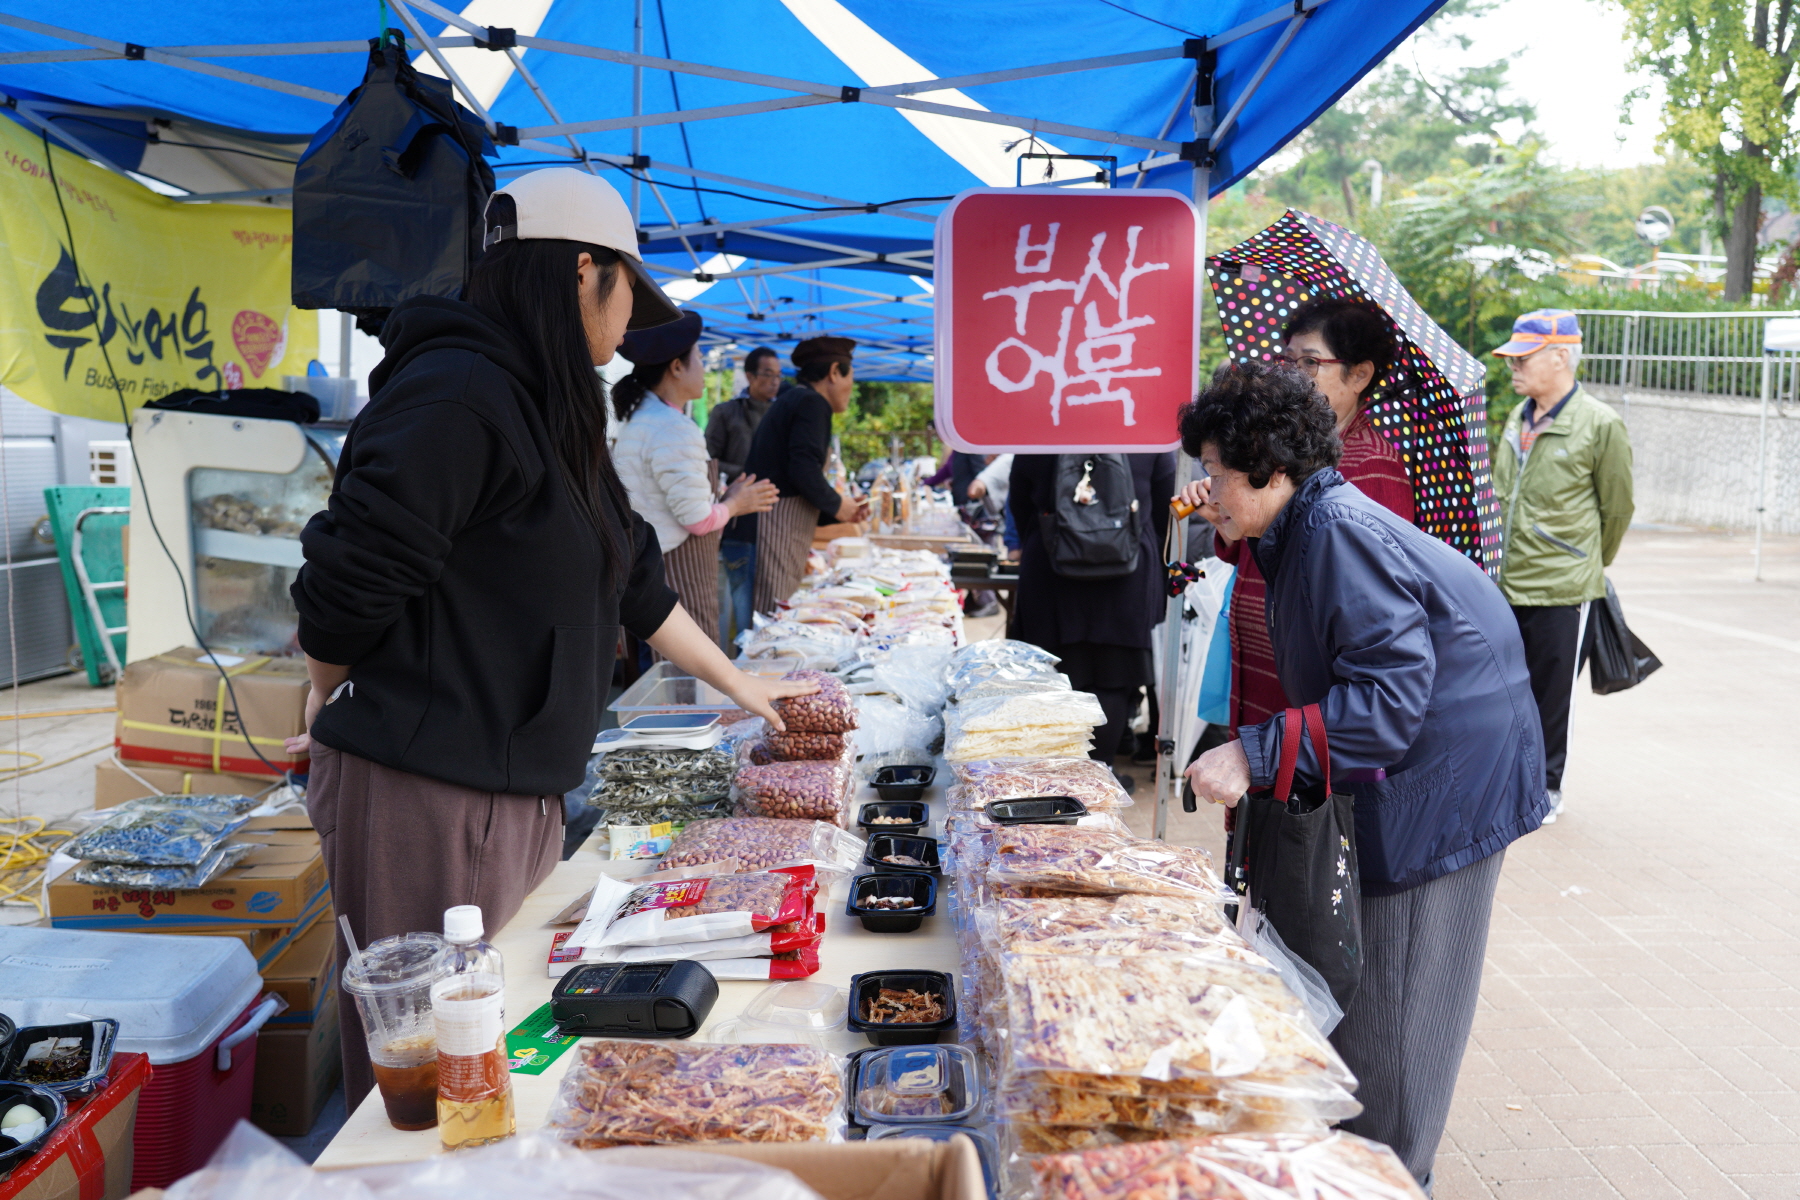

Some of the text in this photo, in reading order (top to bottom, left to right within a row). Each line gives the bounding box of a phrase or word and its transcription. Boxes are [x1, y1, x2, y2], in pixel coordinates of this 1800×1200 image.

[36, 241, 222, 393] 부산어묵
[982, 222, 1170, 339] 부산
[85, 367, 137, 393] Busan
[140, 377, 169, 397] Fish
[984, 305, 1162, 427] 어묵
[92, 896, 121, 911] 마른
[122, 890, 176, 917] 멸치
